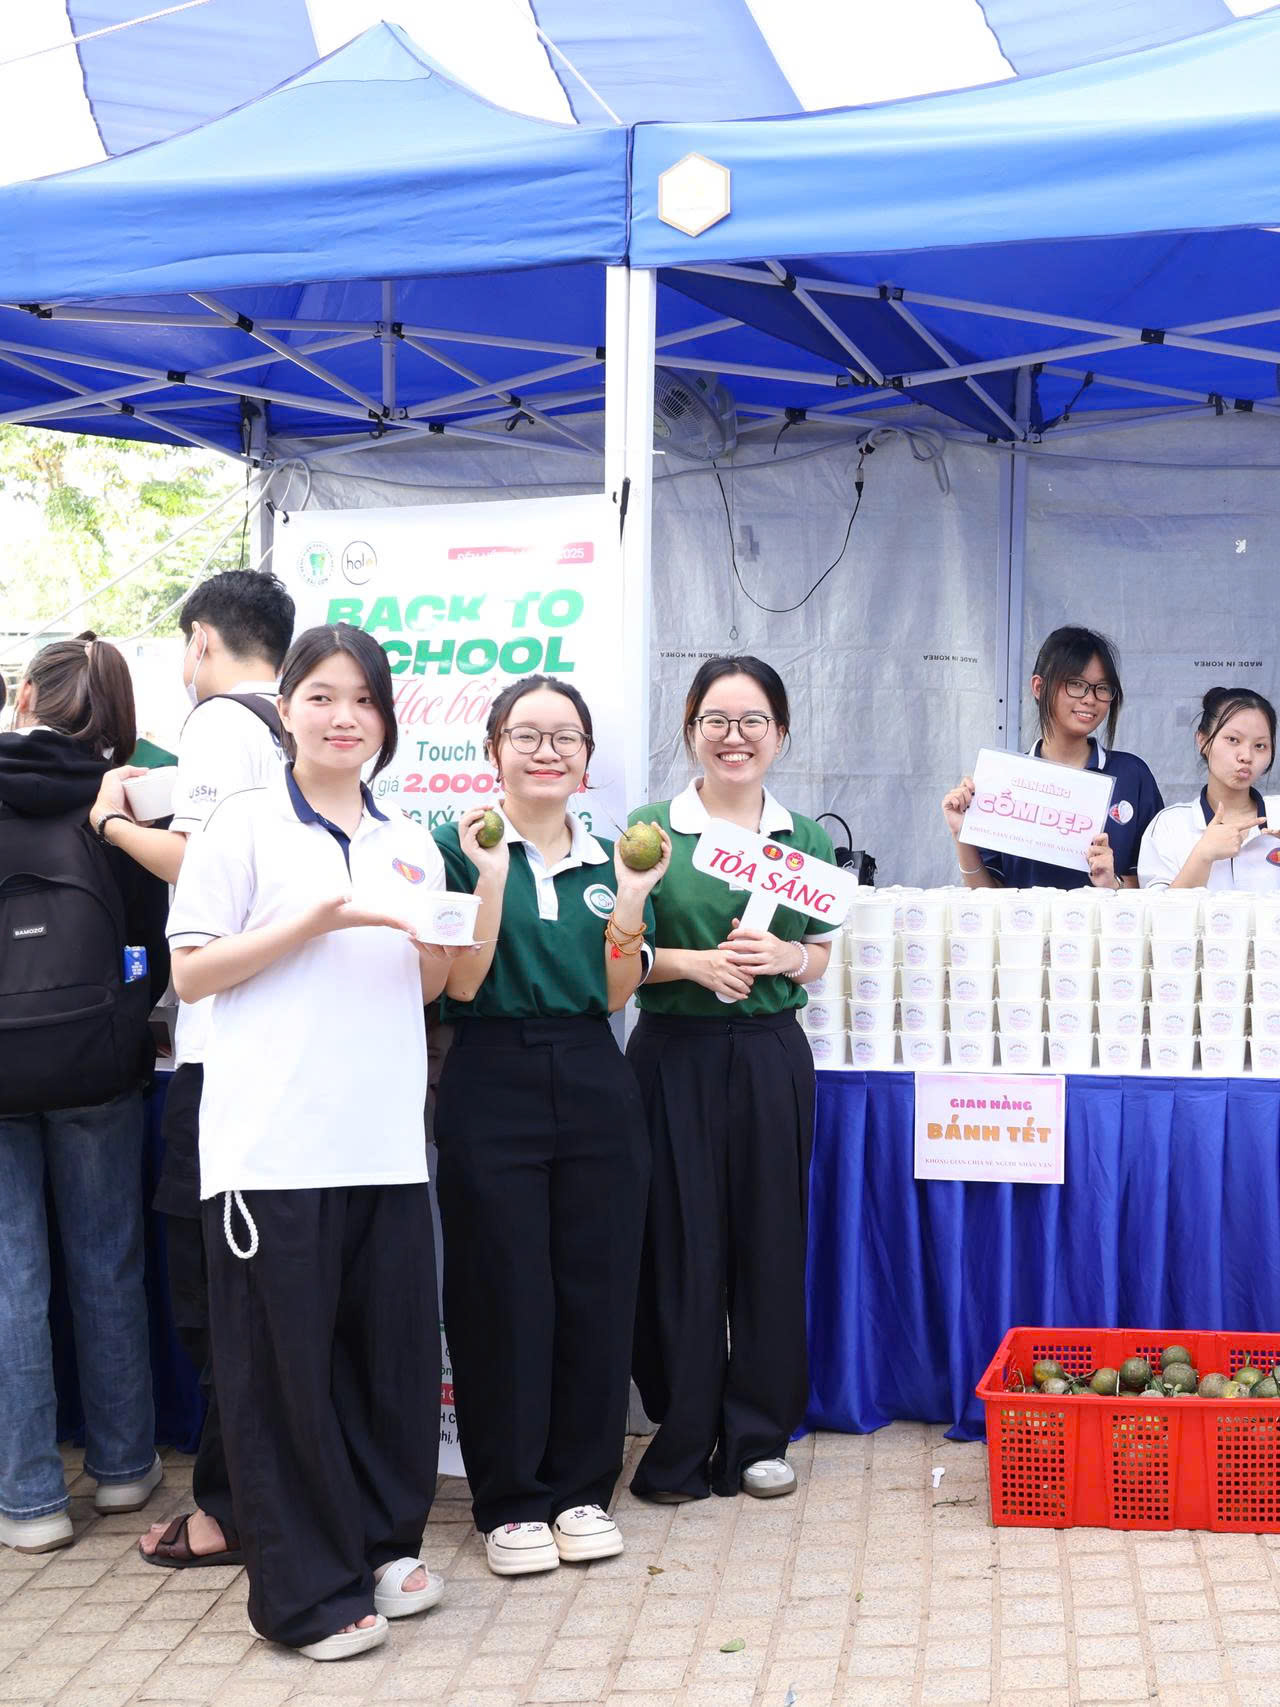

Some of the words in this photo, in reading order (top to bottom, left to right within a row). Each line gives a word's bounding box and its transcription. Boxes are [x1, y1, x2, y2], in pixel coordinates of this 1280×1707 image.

[504, 589, 584, 628] TO
[383, 636, 576, 675] CHOOL
[416, 740, 476, 761] Touch
[977, 788, 1040, 823] CỐM
[709, 848, 758, 883] TỎA
[761, 872, 836, 914] SÁNG
[950, 1098, 986, 1109] GIAN
[990, 1095, 1033, 1111] HÀNG
[927, 1114, 1001, 1142] BÁNH
